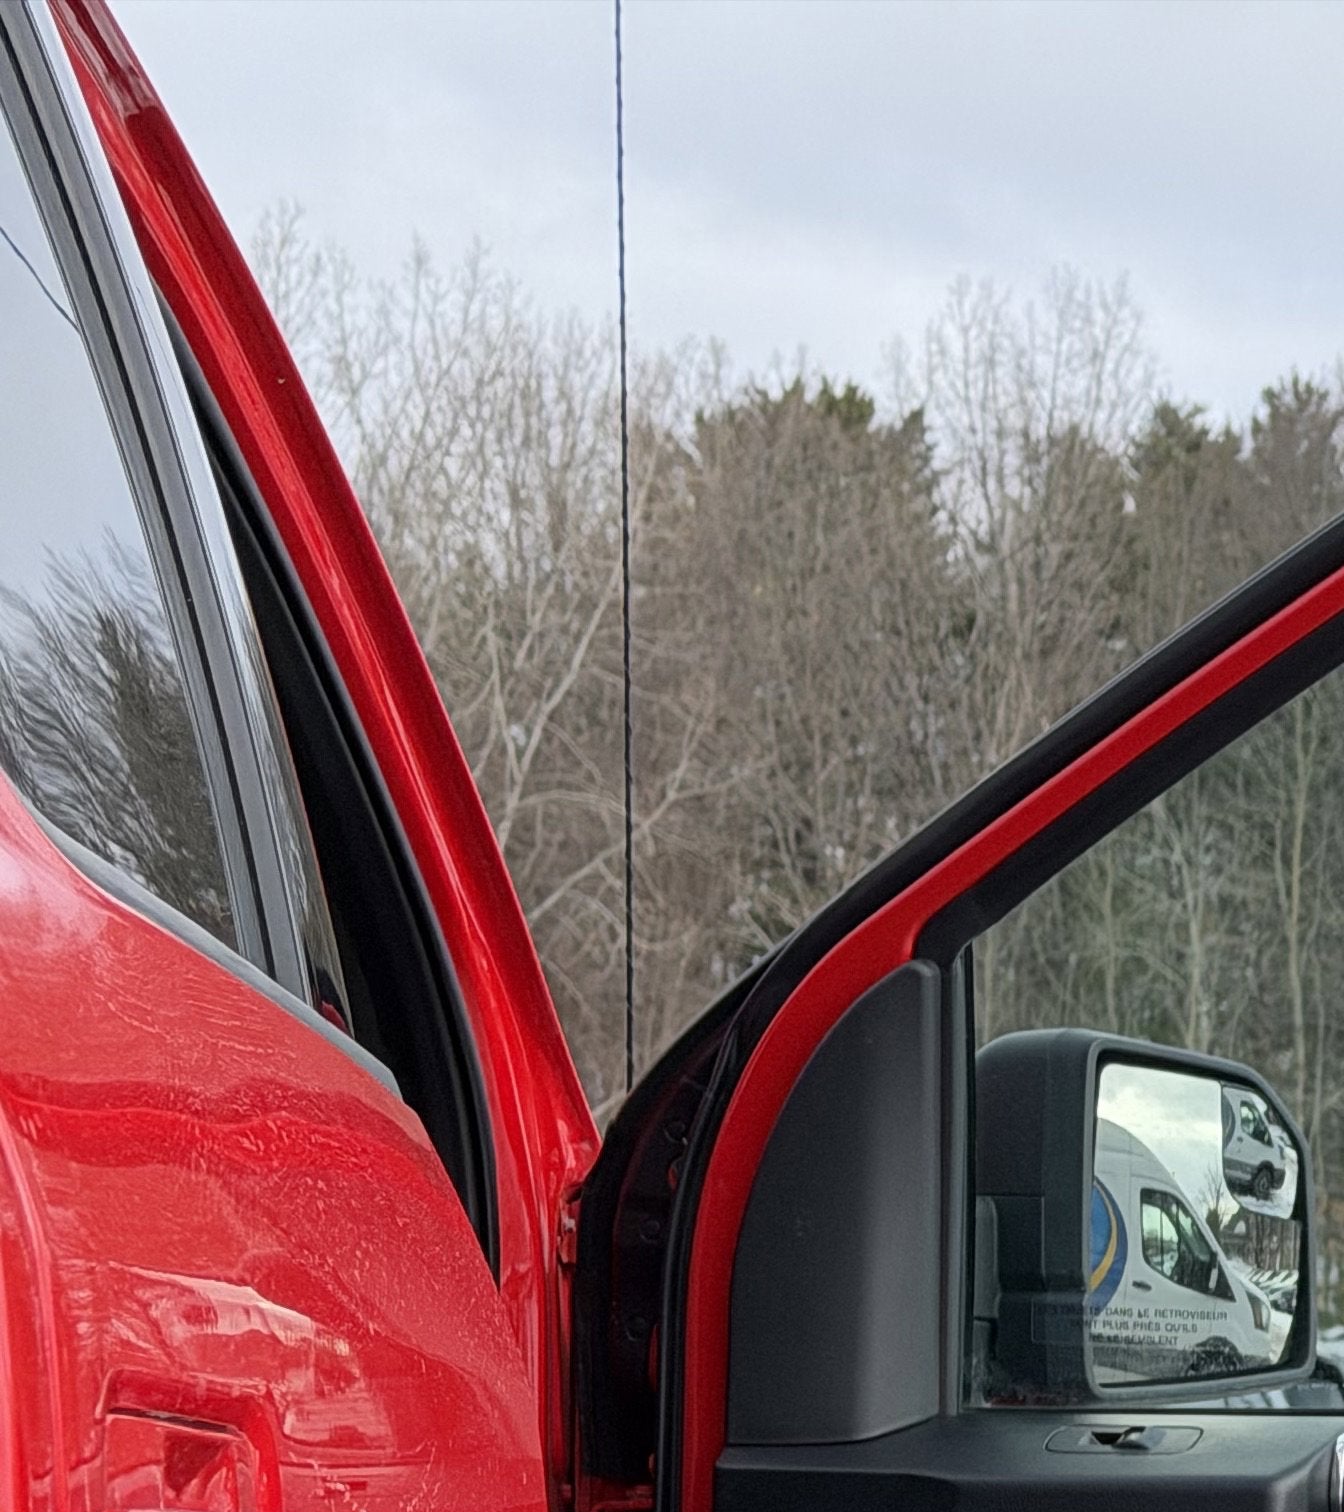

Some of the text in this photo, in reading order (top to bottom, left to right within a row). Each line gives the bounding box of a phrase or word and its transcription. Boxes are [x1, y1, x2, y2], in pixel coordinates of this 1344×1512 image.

[1105, 1307, 1133, 1318] DANS
[1137, 1308, 1150, 1318] LE
[1102, 1320, 1129, 1331] PLUS
